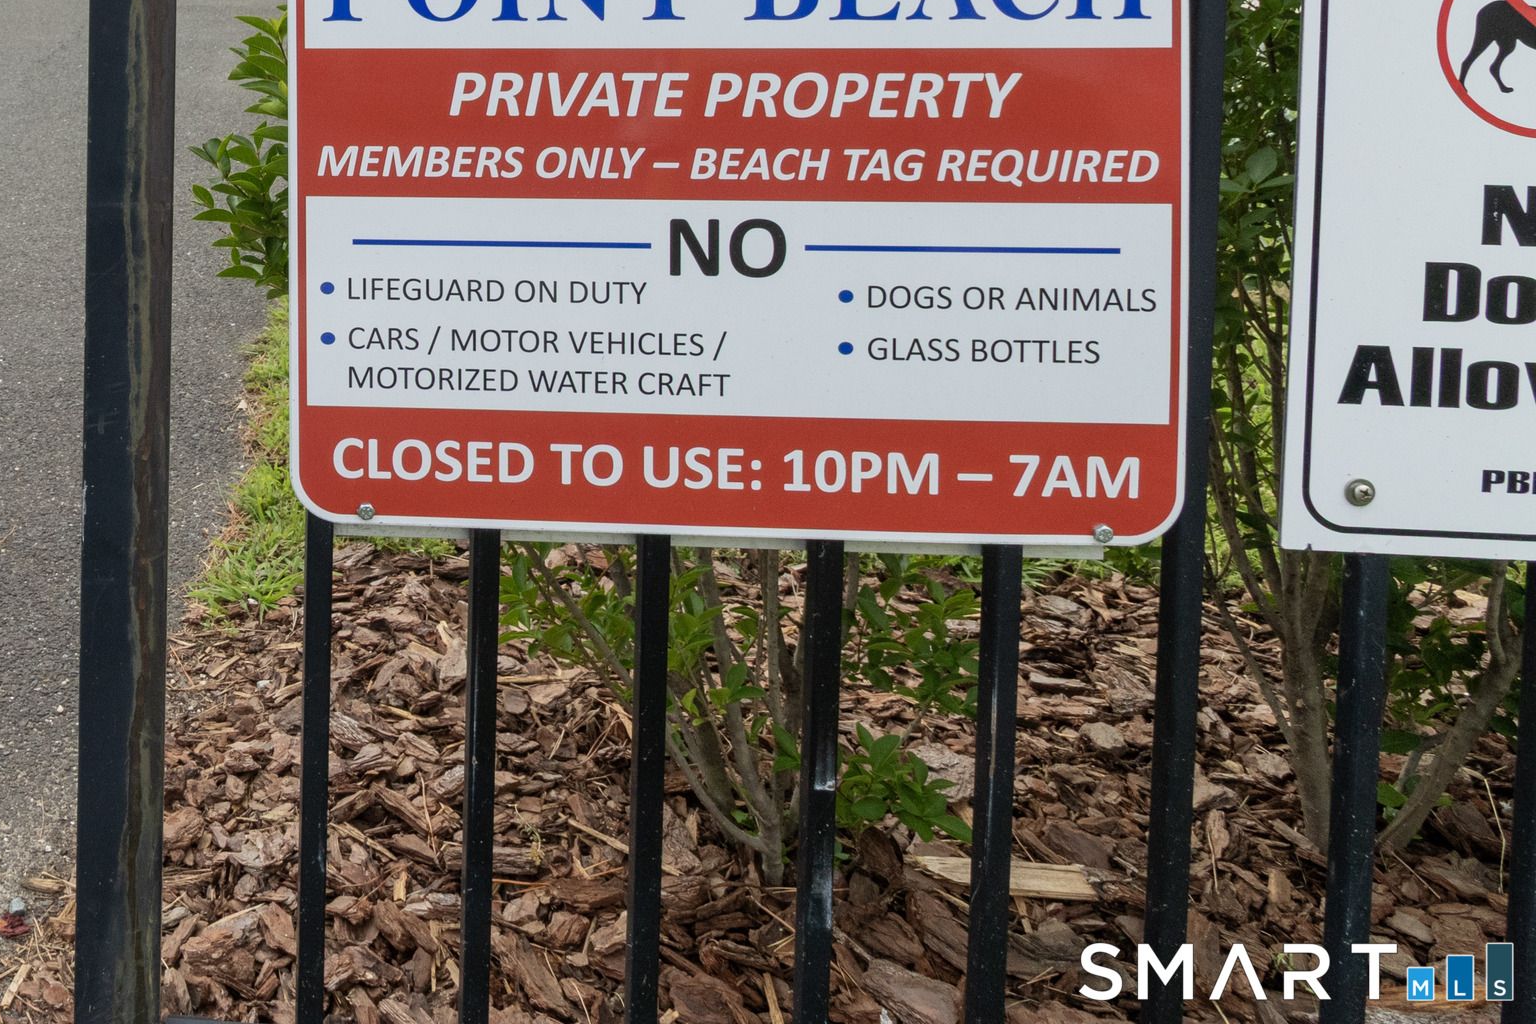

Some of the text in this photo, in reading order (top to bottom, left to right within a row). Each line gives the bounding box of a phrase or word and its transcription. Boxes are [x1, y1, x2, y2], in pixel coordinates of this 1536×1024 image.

[449, 72, 1022, 119] PRIVATE PROPERTY
[318, 145, 524, 179] MEMBERS
[535, 147, 645, 180] ONLY
[690, 148, 830, 181] BEACH
[844, 149, 926, 182] TAG
[937, 150, 1160, 188] REQUIRED
[669, 218, 787, 279] NO
[348, 277, 648, 306] LIFEGUARD ON DUTY
[867, 285, 1158, 313] DOGS OR ANIMALS
[348, 326, 420, 352] CARS
[451, 328, 560, 355] MOTOR
[568, 330, 705, 357] VEHICLES
[867, 337, 1100, 365] GLASS BOTTLES
[348, 366, 731, 397] MOTORIZED WATER CRAFT
[332, 437, 535, 484] CLOSED
[550, 443, 624, 487] TO
[643, 446, 762, 491] USE:
[784, 449, 940, 495] 10PM
[1010, 454, 1140, 499] 7AM
[1481, 469, 1536, 495] PB
